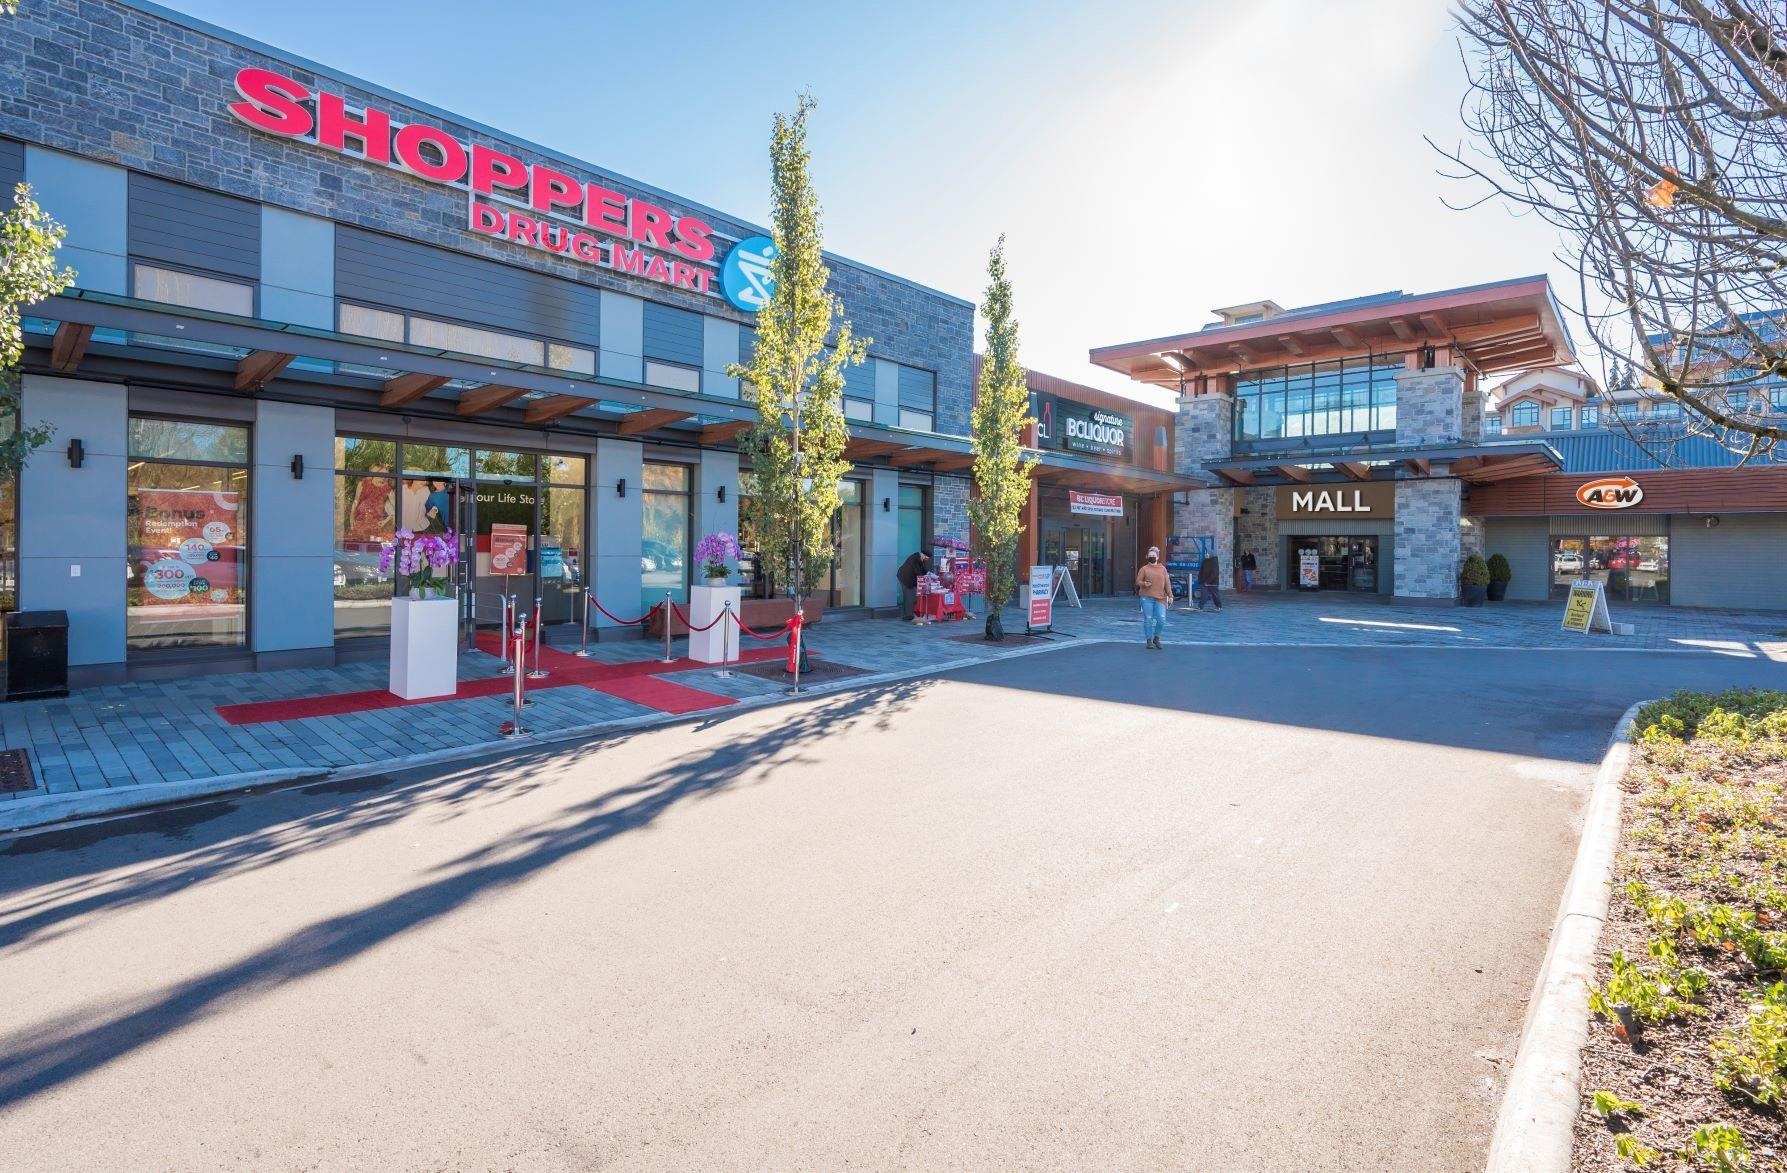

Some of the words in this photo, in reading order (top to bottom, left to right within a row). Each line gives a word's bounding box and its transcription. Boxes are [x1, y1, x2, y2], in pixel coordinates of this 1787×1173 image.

[226, 66, 715, 262] SHOPPERS
[470, 202, 601, 264] DRUG
[612, 246, 716, 294] MART
[1093, 410, 1123, 426] signature
[1037, 423, 1049, 438] CL
[476, 494, 494, 502] our
[498, 493, 516, 503] Life
[519, 494, 534, 504] Sto
[1292, 490, 1371, 512] MALL
[1586, 489, 1638, 502] A&W
